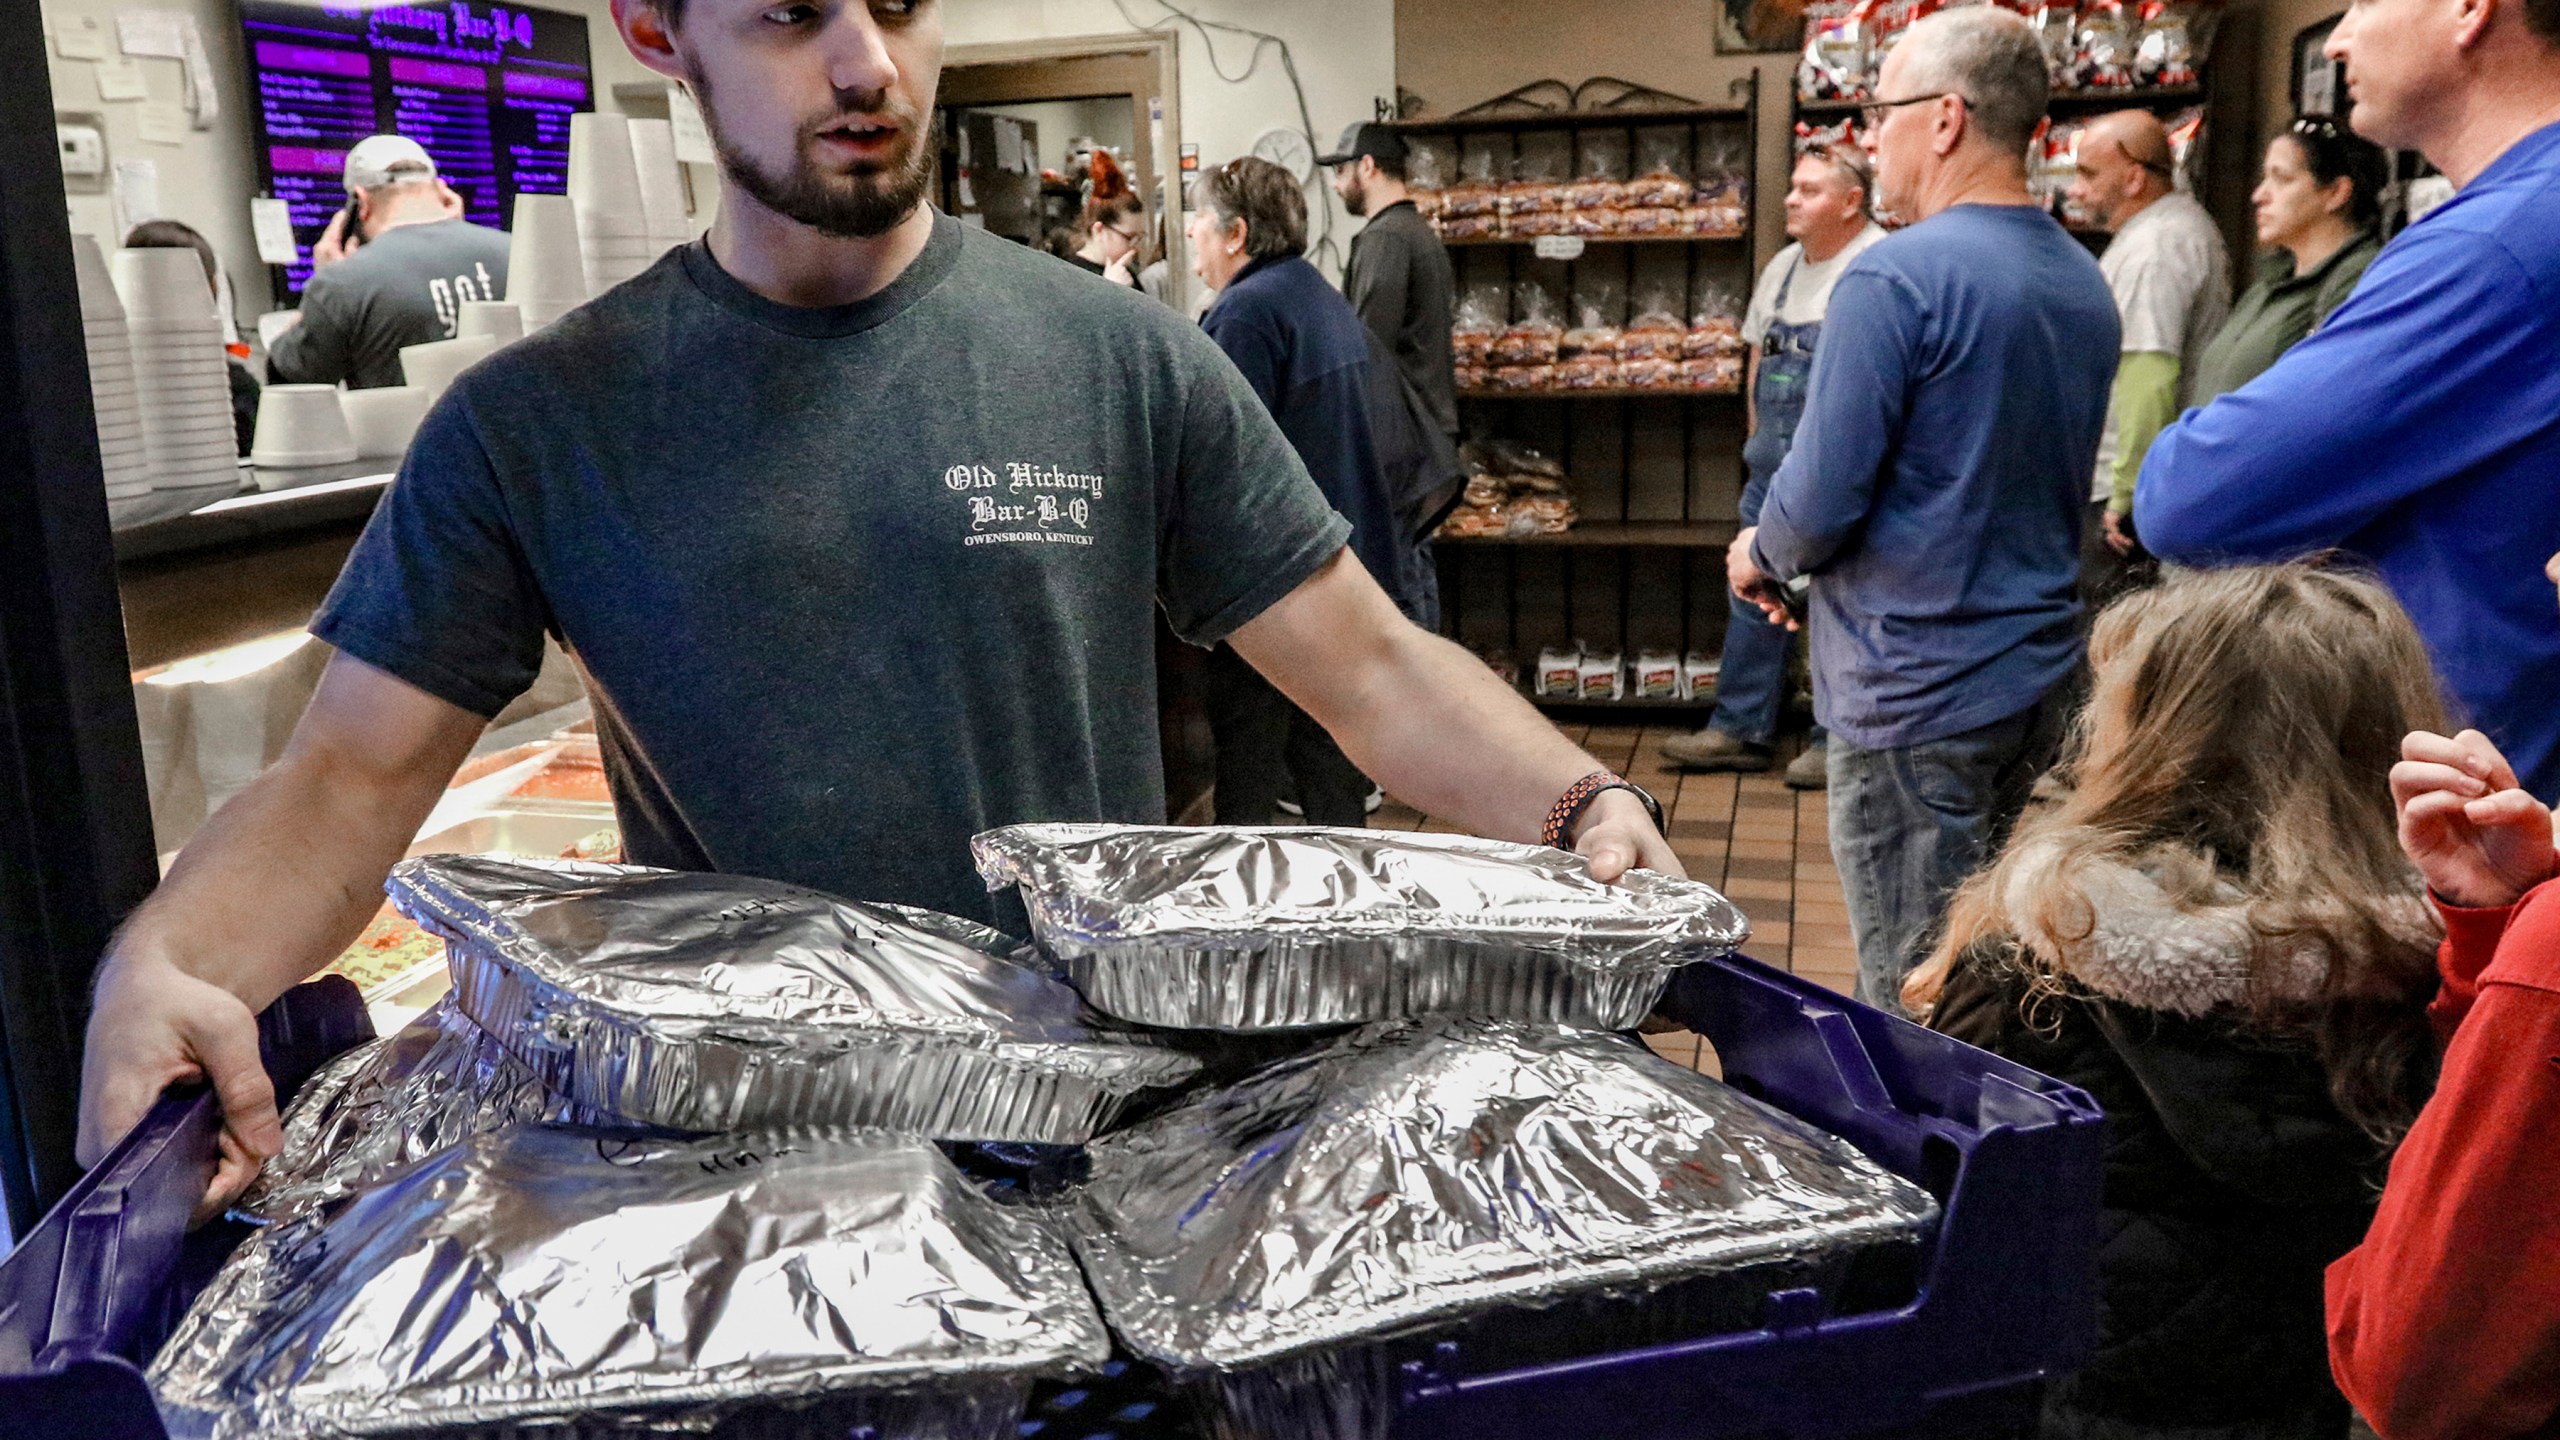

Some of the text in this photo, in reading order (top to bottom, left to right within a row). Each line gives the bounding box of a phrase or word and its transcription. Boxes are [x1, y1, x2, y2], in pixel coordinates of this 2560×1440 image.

[944, 462, 1104, 499] Old Hickory
[967, 494, 1090, 532] Bar-B-Q
[964, 531, 1095, 547] OWENSBORO, KENTUCKY
